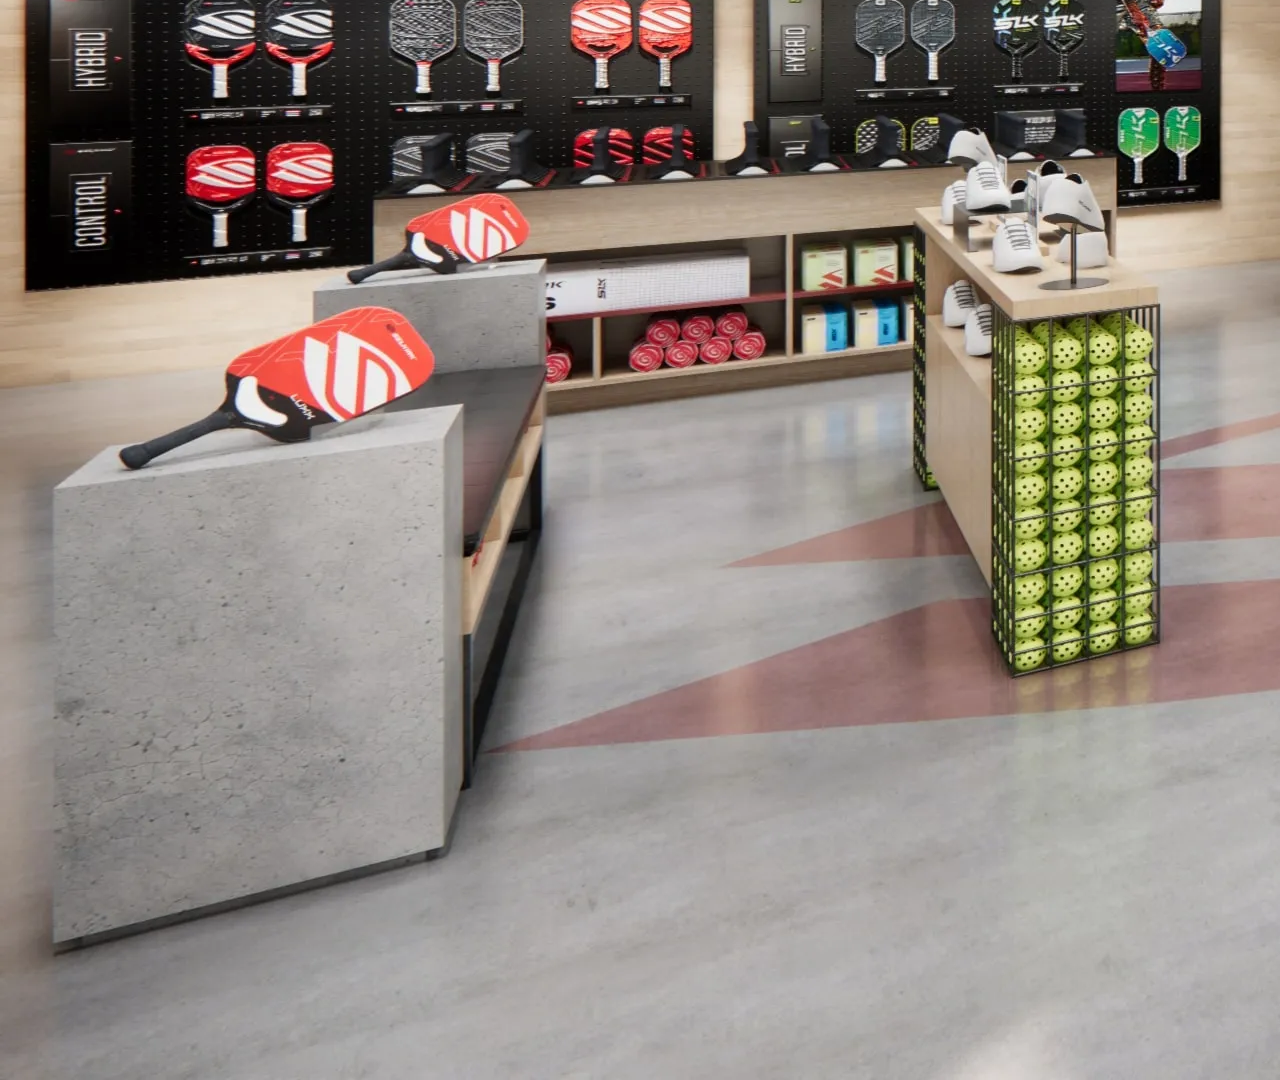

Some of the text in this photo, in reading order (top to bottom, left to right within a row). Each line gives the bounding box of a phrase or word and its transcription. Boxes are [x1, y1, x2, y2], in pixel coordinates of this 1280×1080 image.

[994, 14, 1040, 31] SLK
[1043, 13, 1085, 28] SLK
[75, 30, 106, 88] HYBRID
[785, 27, 806, 72] HYBRID
[75, 177, 107, 248] CONTROL
